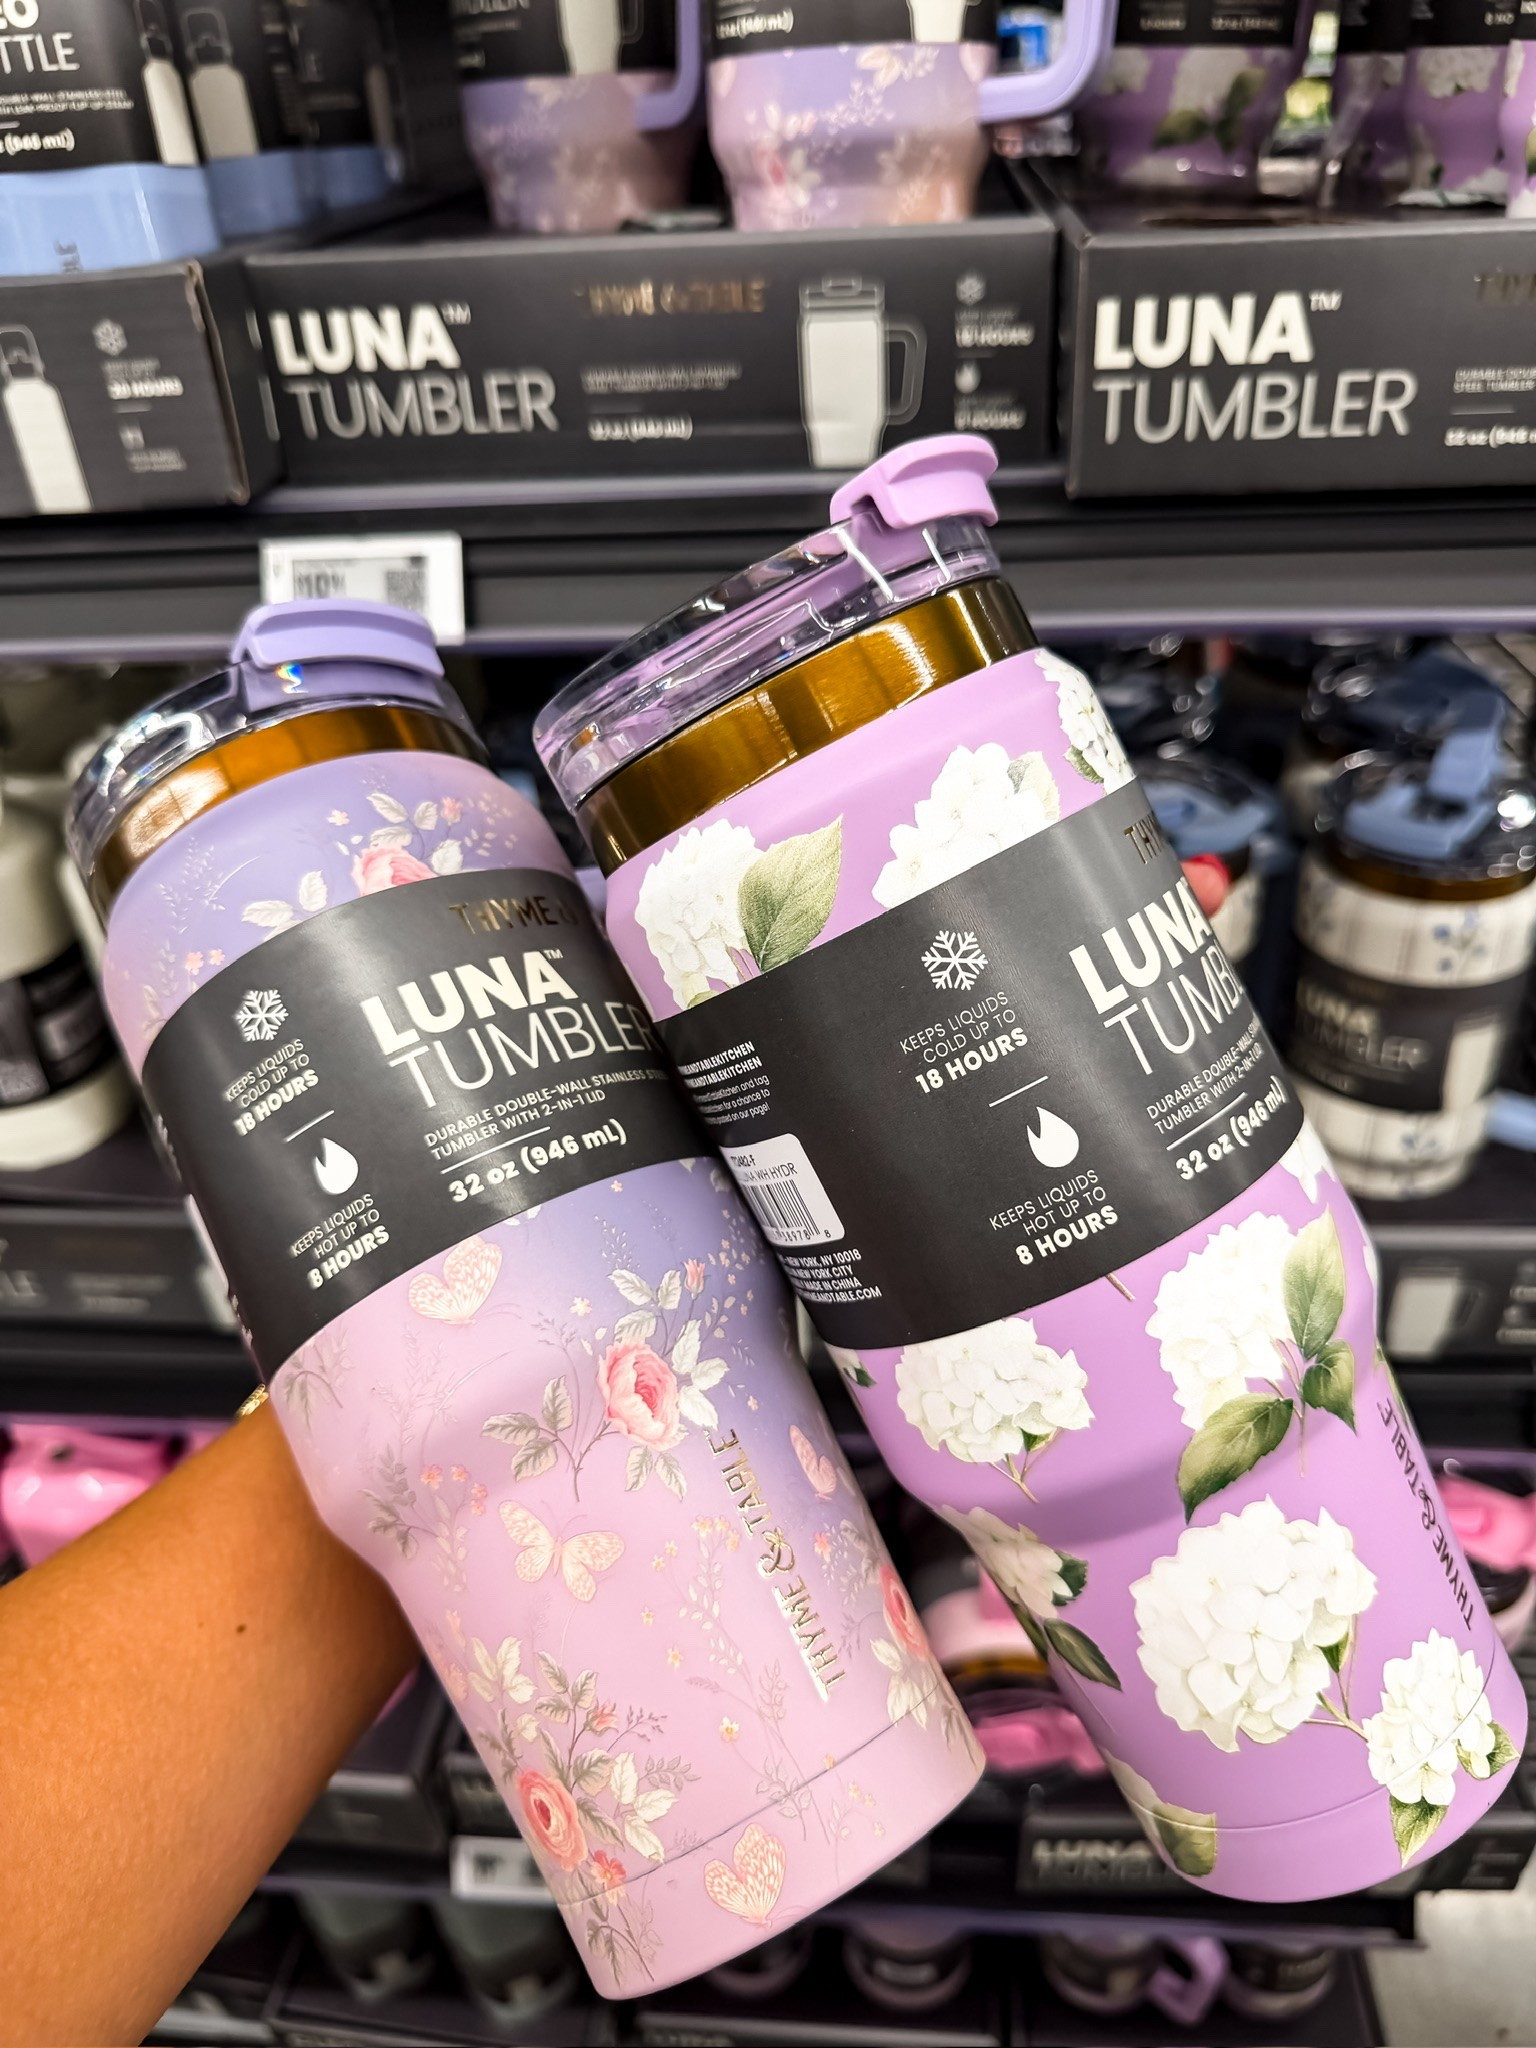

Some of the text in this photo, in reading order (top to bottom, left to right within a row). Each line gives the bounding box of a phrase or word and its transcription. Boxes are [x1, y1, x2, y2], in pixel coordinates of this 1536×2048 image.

[283, 368, 559, 440] TUMBLER
[1092, 369, 1418, 444] TUMBLER
[449, 896, 558, 934] THYME
[900, 991, 1008, 1054] KEEPS LIQUIDS
[923, 1009, 1015, 1063] COLD UP TO
[224, 1039, 304, 1102] KEEPS LIQUIDS
[239, 1053, 309, 1108] COLD UP TO
[388, 1001, 663, 1108] TUMBLER
[740, 1075, 770, 1091] and tag
[915, 1027, 1028, 1093] 18 HOURS
[1146, 1032, 1252, 1119] DURABLE DOUBLE-WALL
[233, 1069, 319, 1136] 18 HOURS
[424, 1108, 493, 1147] DURABLE
[493, 1080, 591, 1116] DOUBLE-WALL
[591, 1070, 646, 1086] STAINLESS
[431, 1089, 606, 1160] TUMBLER WITH 2-IN-1 LID
[737, 1093, 761, 1106] chance
[761, 1089, 770, 1098] to
[749, 1102, 770, 1118] page!
[1154, 1092, 1212, 1134] TUMBLER
[1210, 1073, 1237, 1098] WITH
[449, 1118, 627, 1203] 32 oz (946 mL)
[754, 1168, 770, 1180] WH
[770, 1163, 798, 1179] HYDR
[1176, 1150, 1208, 1180] 32
[1208, 1134, 1235, 1161] oz
[1230, 1100, 1269, 1147] (946
[289, 1193, 374, 1258] KEEPS LIQUIDS
[989, 1169, 1098, 1230] KEEPS LIQUIDS
[1022, 1186, 1106, 1236] HOT UP TO
[307, 1225, 389, 1290] 8 HOURS
[312, 1209, 380, 1259] HOT UP TO
[800, 1257, 822, 1268] YORK,
[820, 1254, 834, 1265] NY
[833, 1248, 861, 1264] 10018
[824, 1230, 831, 1238] 8
[1015, 1205, 1118, 1265] 8 HOURS
[803, 1276, 862, 1291] MADE IN CHINA
[810, 1268, 832, 1279] YORK
[832, 1264, 853, 1277] CITY
[1377, 1398, 1421, 1496] TABLE
[1432, 1525, 1475, 1631] THYME
[772, 1576, 846, 1703] THYME
